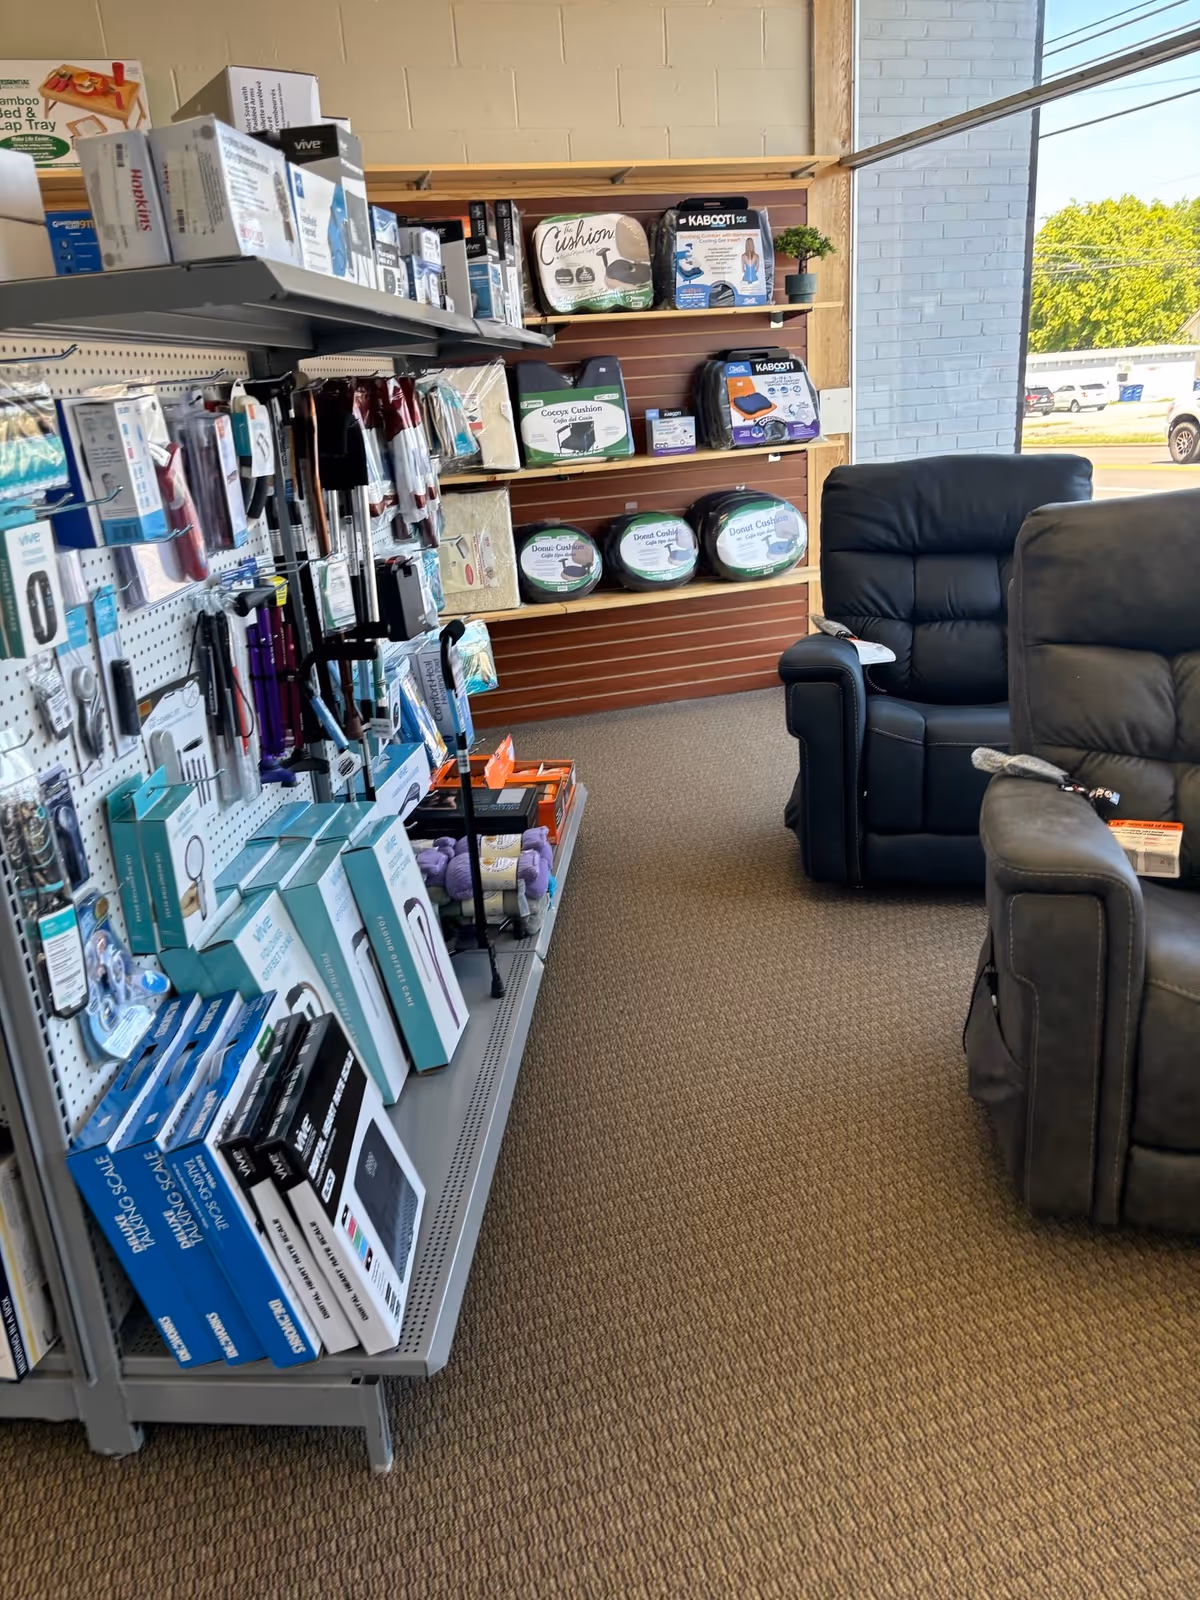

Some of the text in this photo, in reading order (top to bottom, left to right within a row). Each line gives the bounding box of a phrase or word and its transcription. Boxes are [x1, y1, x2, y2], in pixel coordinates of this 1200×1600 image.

[0, 96, 39, 105] amboo
[26, 107, 35, 118] &
[25, 119, 56, 132] Tray
[294, 139, 321, 150] vive
[131, 168, 152, 232] Hopkins
[688, 214, 735, 226] KABOOTI
[540, 219, 616, 266] Cushion
[755, 361, 794, 372] KABOOTI
[541, 405, 602, 417] Coccyx Cushion
[18, 532, 41, 546] vive
[633, 528, 683, 541] Donut Cushio
[728, 515, 789, 537] Donut Cushion
[531, 543, 585, 553] Donut Cushion
[261, 951, 282, 981] OFFSET
[321, 952, 339, 991] FOLDING
[376, 915, 416, 1007] FOLDING OFFSET CANE
[258, 1062, 271, 1080] SCALE
[285, 1080, 297, 1097] RATE
[291, 1063, 304, 1081] SCALE
[308, 1137, 327, 1180] DIGITAL
[322, 1101, 337, 1140] HEART
[333, 1077, 346, 1108] RATE
[341, 1050, 355, 1083] SCALE
[294, 1113, 312, 1152] vive
[143, 1149, 177, 1191] SCALE
[195, 1154, 217, 1190] Extra Wide
[231, 1148, 252, 1177] vive
[268, 1153, 288, 1180] vive
[94, 1153, 157, 1248] TALKING SCALE
[184, 1157, 213, 1200] TALKING
[205, 1200, 230, 1232] SCALE
[324, 1173, 334, 1198] BLACK
[162, 1208, 196, 1250] DELUXE
[166, 1191, 205, 1245] TALKING
[113, 1213, 148, 1254] DELUXE
[272, 1218, 331, 1320] DIGITAL HEART RATE SCALE
[309, 1221, 369, 1321] DIGITAL HEART RATE SCALE
[2, 1296, 12, 1317] BOX
[8, 1322, 17, 1335] IN
[11, 1333, 27, 1375] BEDDING
